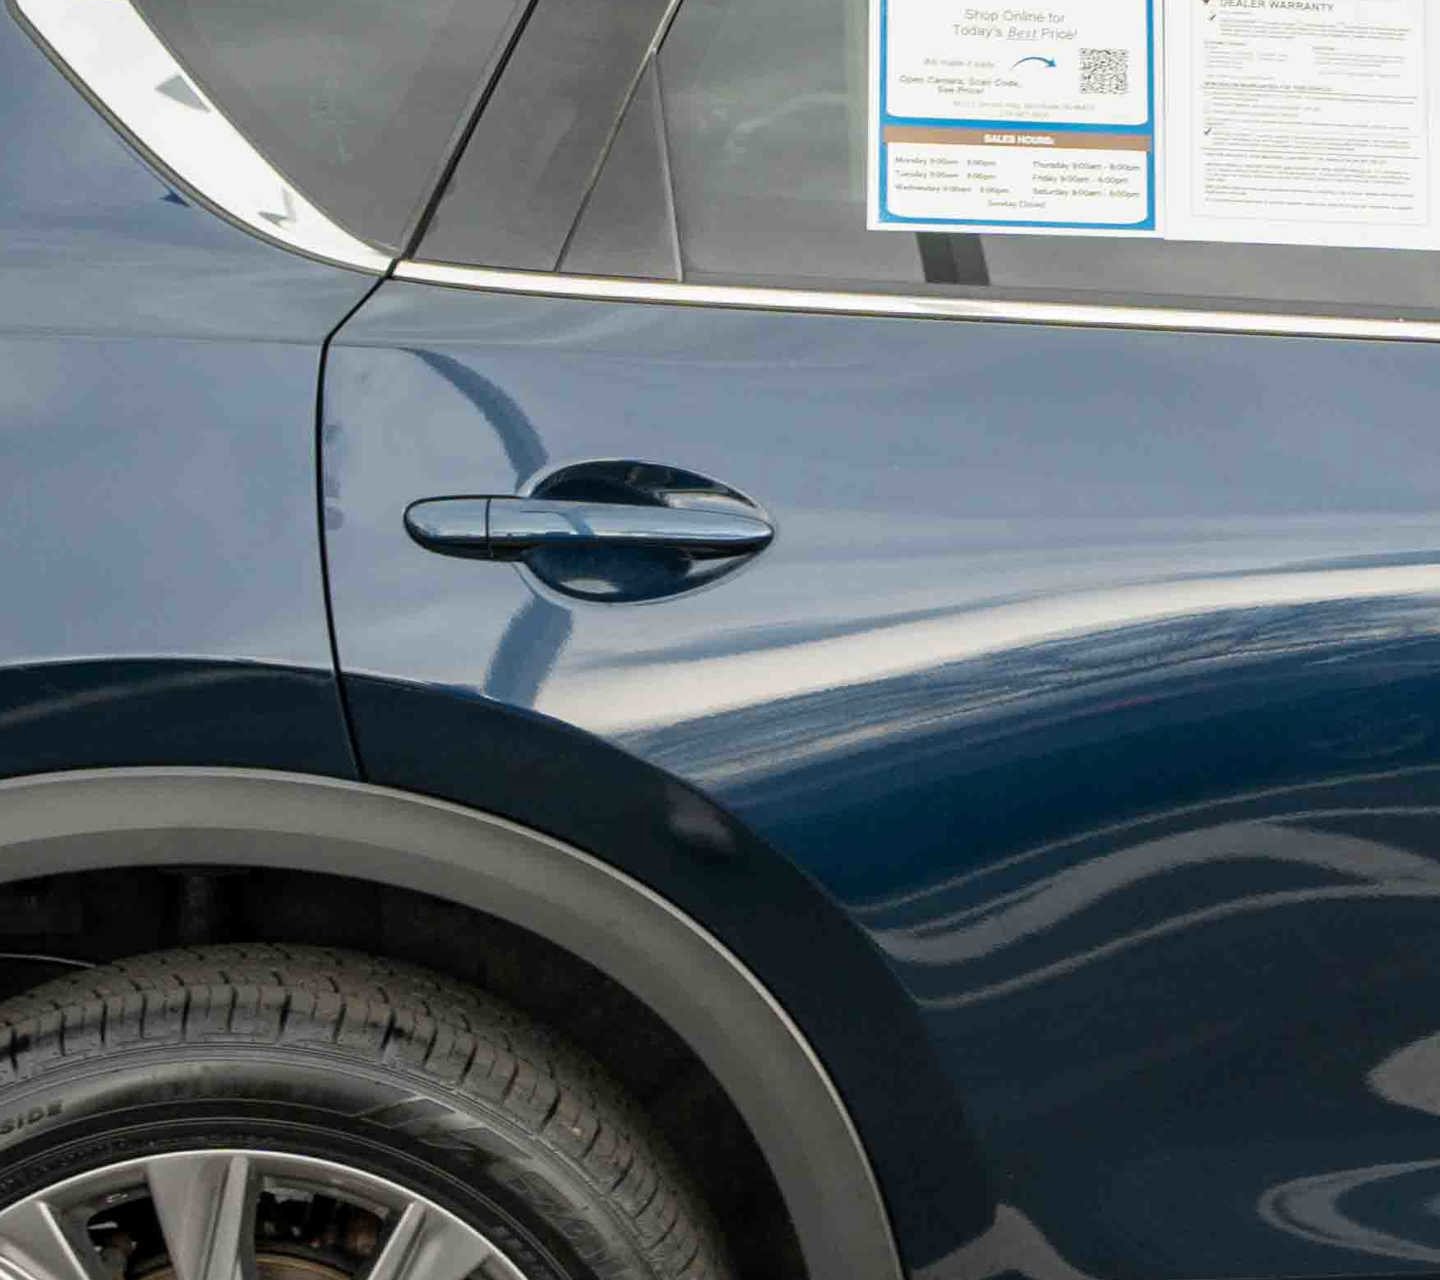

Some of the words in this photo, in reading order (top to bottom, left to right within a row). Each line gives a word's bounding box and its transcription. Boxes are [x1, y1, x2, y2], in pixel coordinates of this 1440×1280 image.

[1269, 0, 1335, 12] WARRANTY
[965, 8, 999, 23] Shop
[1003, 10, 1044, 22] Online
[953, 24, 1003, 39] Today's
